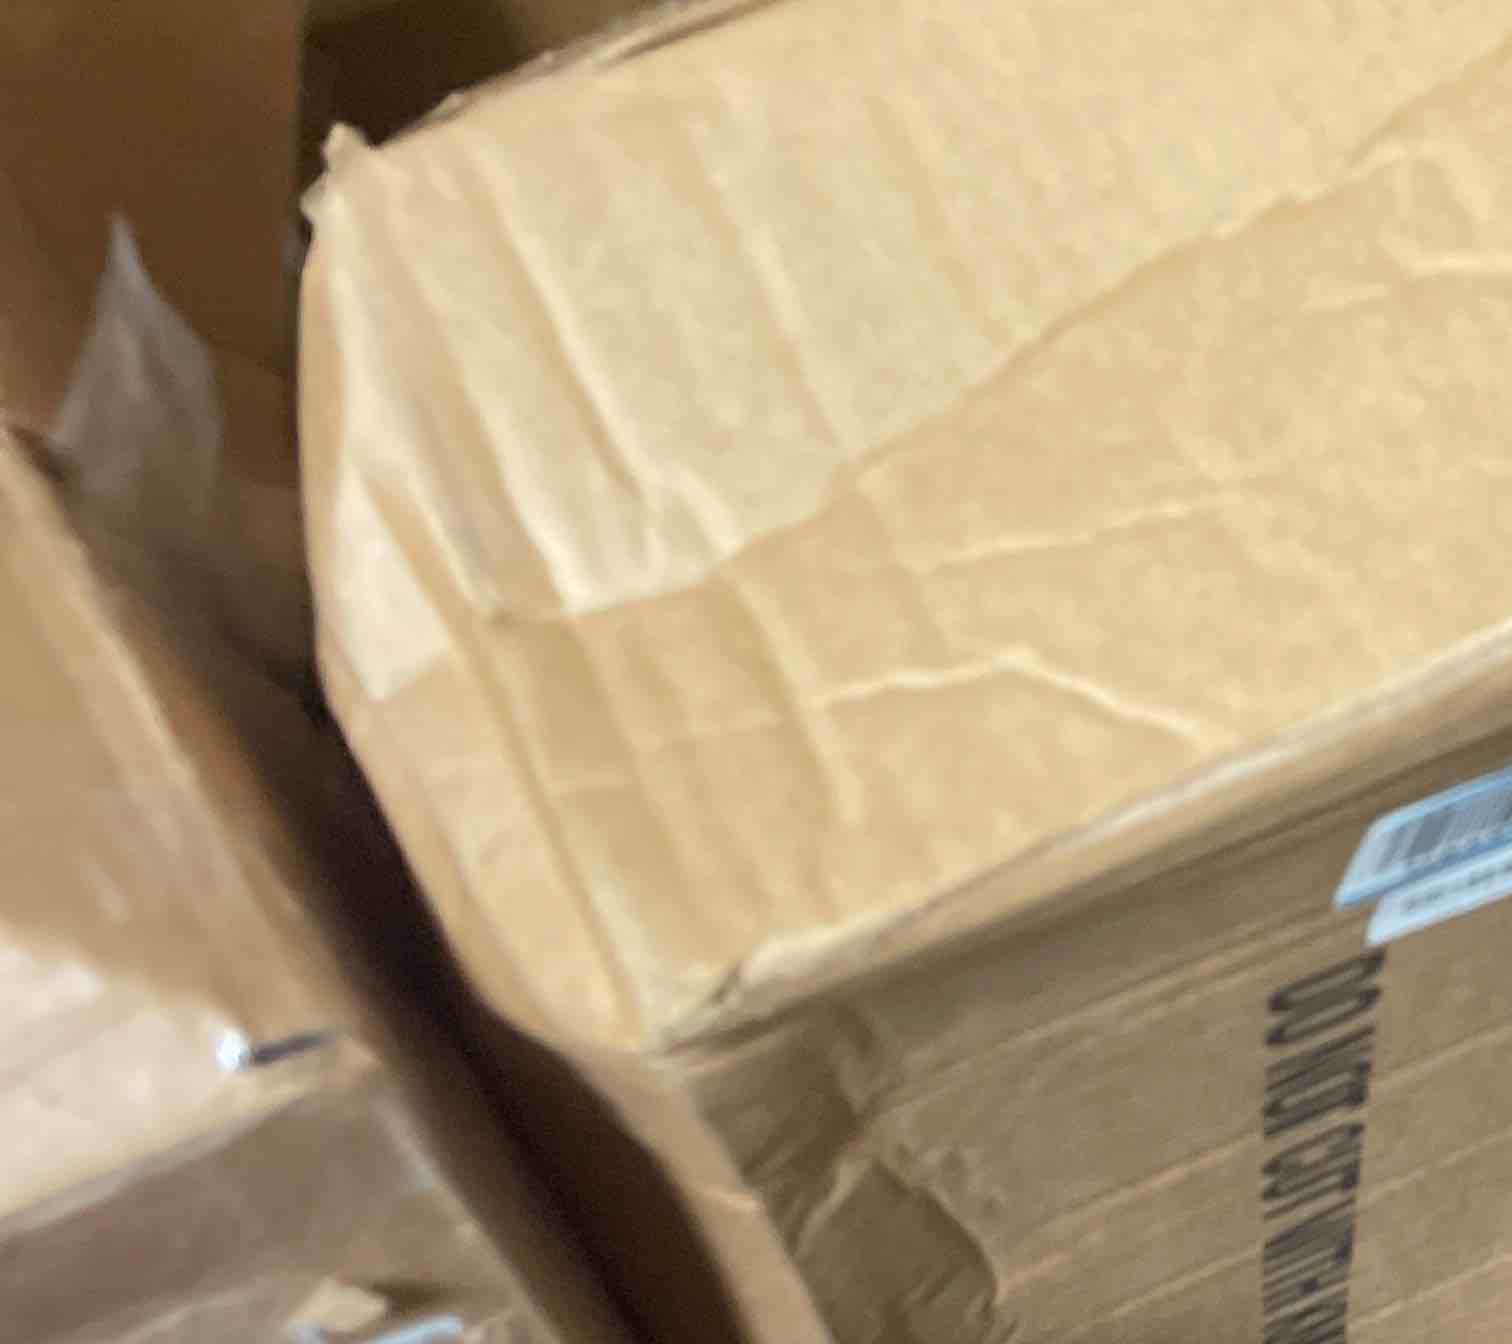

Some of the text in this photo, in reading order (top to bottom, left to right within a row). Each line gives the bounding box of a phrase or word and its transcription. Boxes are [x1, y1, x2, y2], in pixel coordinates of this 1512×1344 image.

[1266, 947, 1386, 1046] DO
[1263, 1024, 1374, 1137] NOT
[1262, 1122, 1364, 1223] CUT
[1262, 1198, 1356, 1316] WITH
